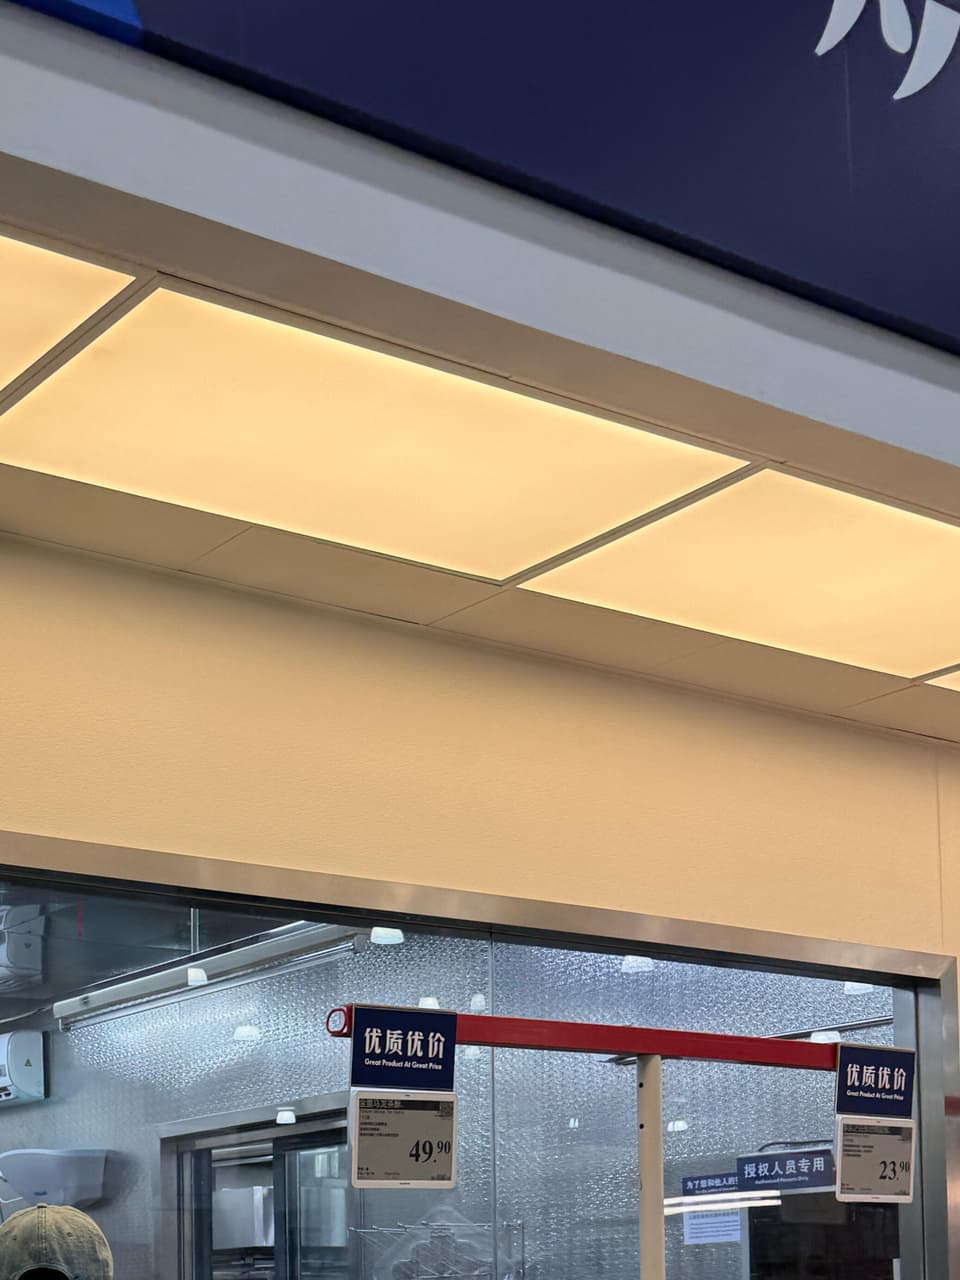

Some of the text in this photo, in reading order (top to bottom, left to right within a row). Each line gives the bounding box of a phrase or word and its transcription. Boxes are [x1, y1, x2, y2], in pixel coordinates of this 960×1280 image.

[364, 1027, 445, 1058] 优质优价
[365, 1058, 381, 1066] Great
[382, 1059, 403, 1068] Product
[412, 1061, 428, 1069] Great
[846, 1063, 906, 1091] 优质优价
[409, 1139, 451, 1163] 49.90
[743, 1157, 825, 1179] 授权人员专用
[879, 1160, 910, 1181] 23.90
